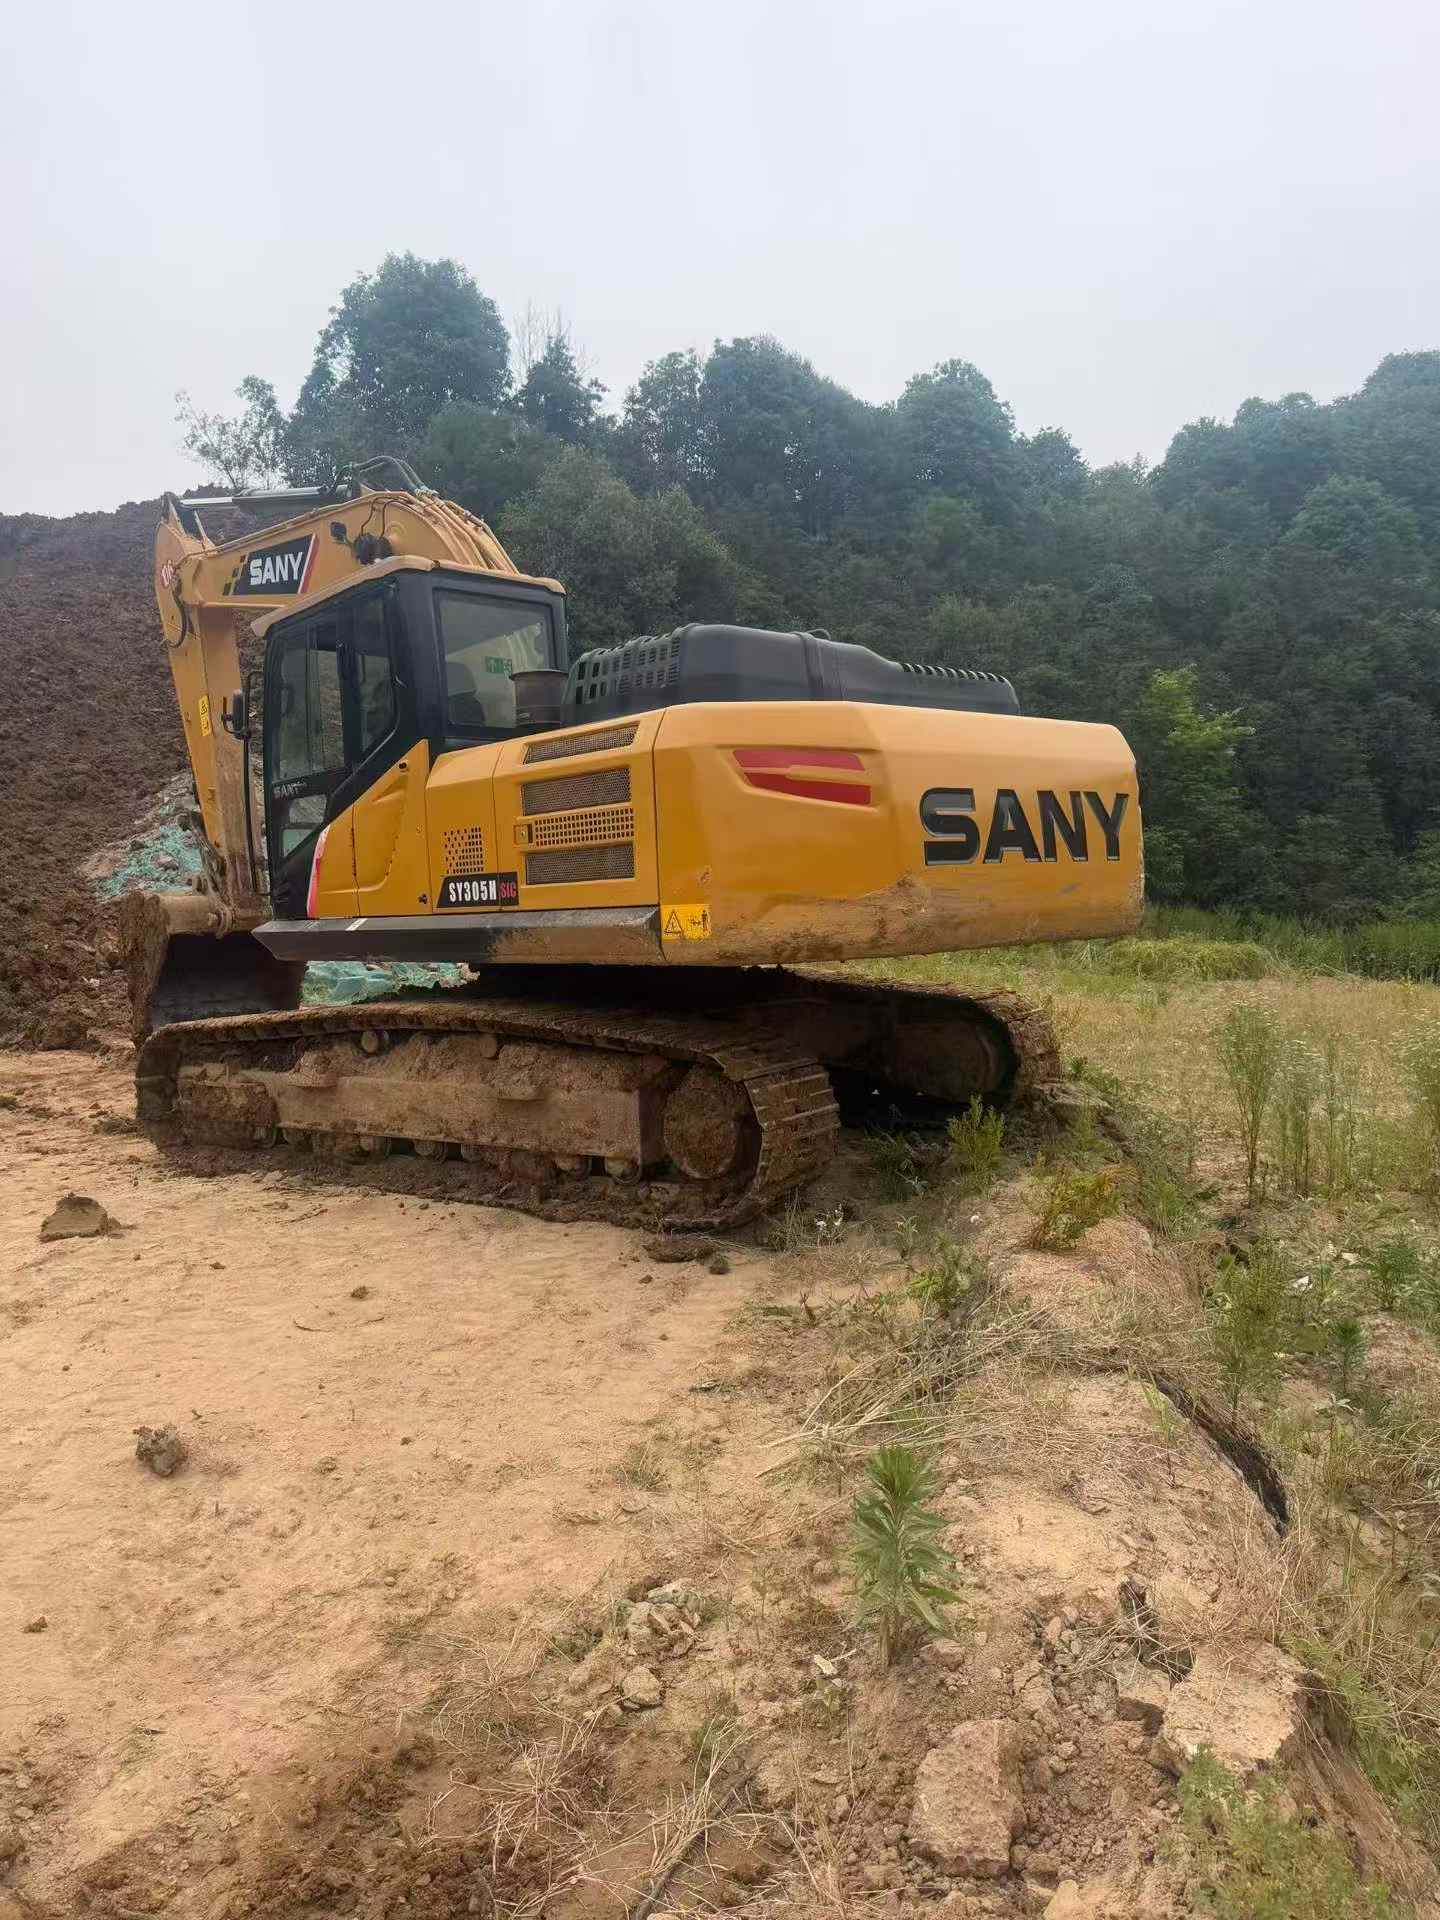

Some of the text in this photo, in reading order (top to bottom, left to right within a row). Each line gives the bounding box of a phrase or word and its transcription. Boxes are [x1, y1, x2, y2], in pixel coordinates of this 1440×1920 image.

[250, 552, 303, 585] SANY
[919, 787, 1130, 866] SANY
[449, 880, 497, 902] SY305H
